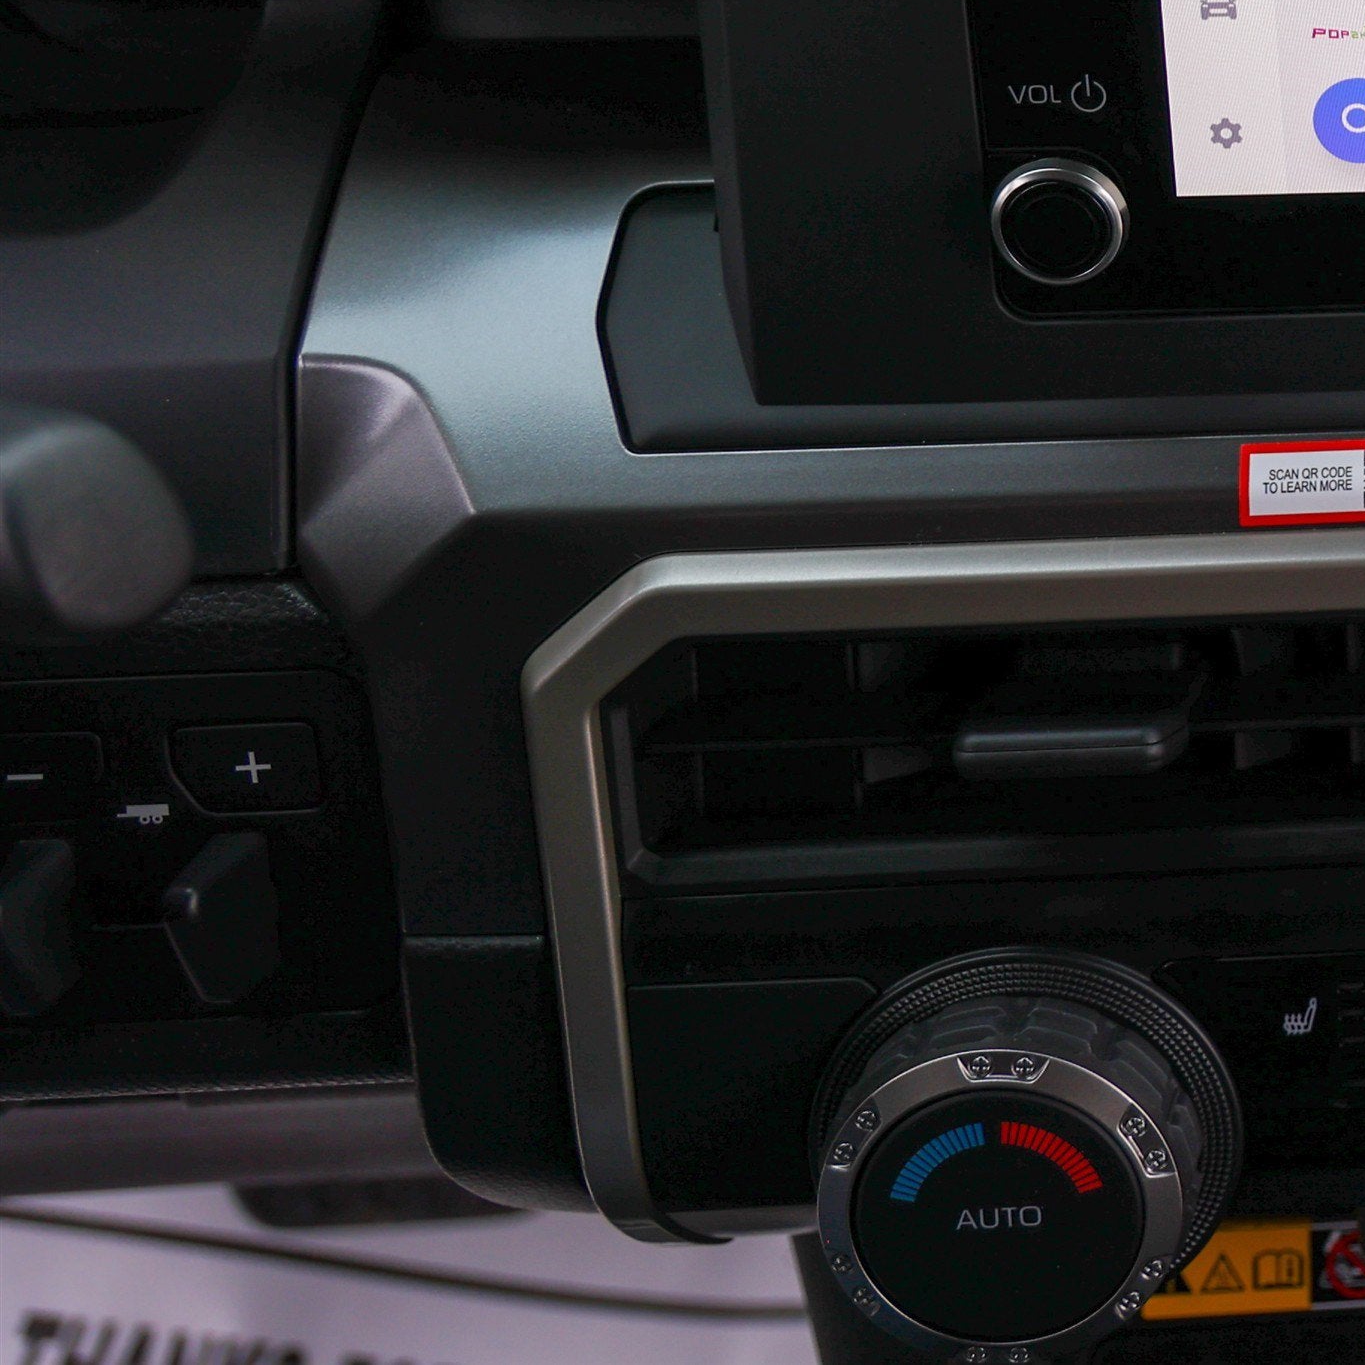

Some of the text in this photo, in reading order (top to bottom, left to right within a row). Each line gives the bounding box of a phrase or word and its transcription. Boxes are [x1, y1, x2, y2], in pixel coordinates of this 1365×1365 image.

[1008, 84, 1061, 104] VOL
[1269, 466, 1352, 481] SCAN QR CODE
[1263, 479, 1352, 494] TO LEARN MORE
[956, 1205, 1043, 1231] AUTO
